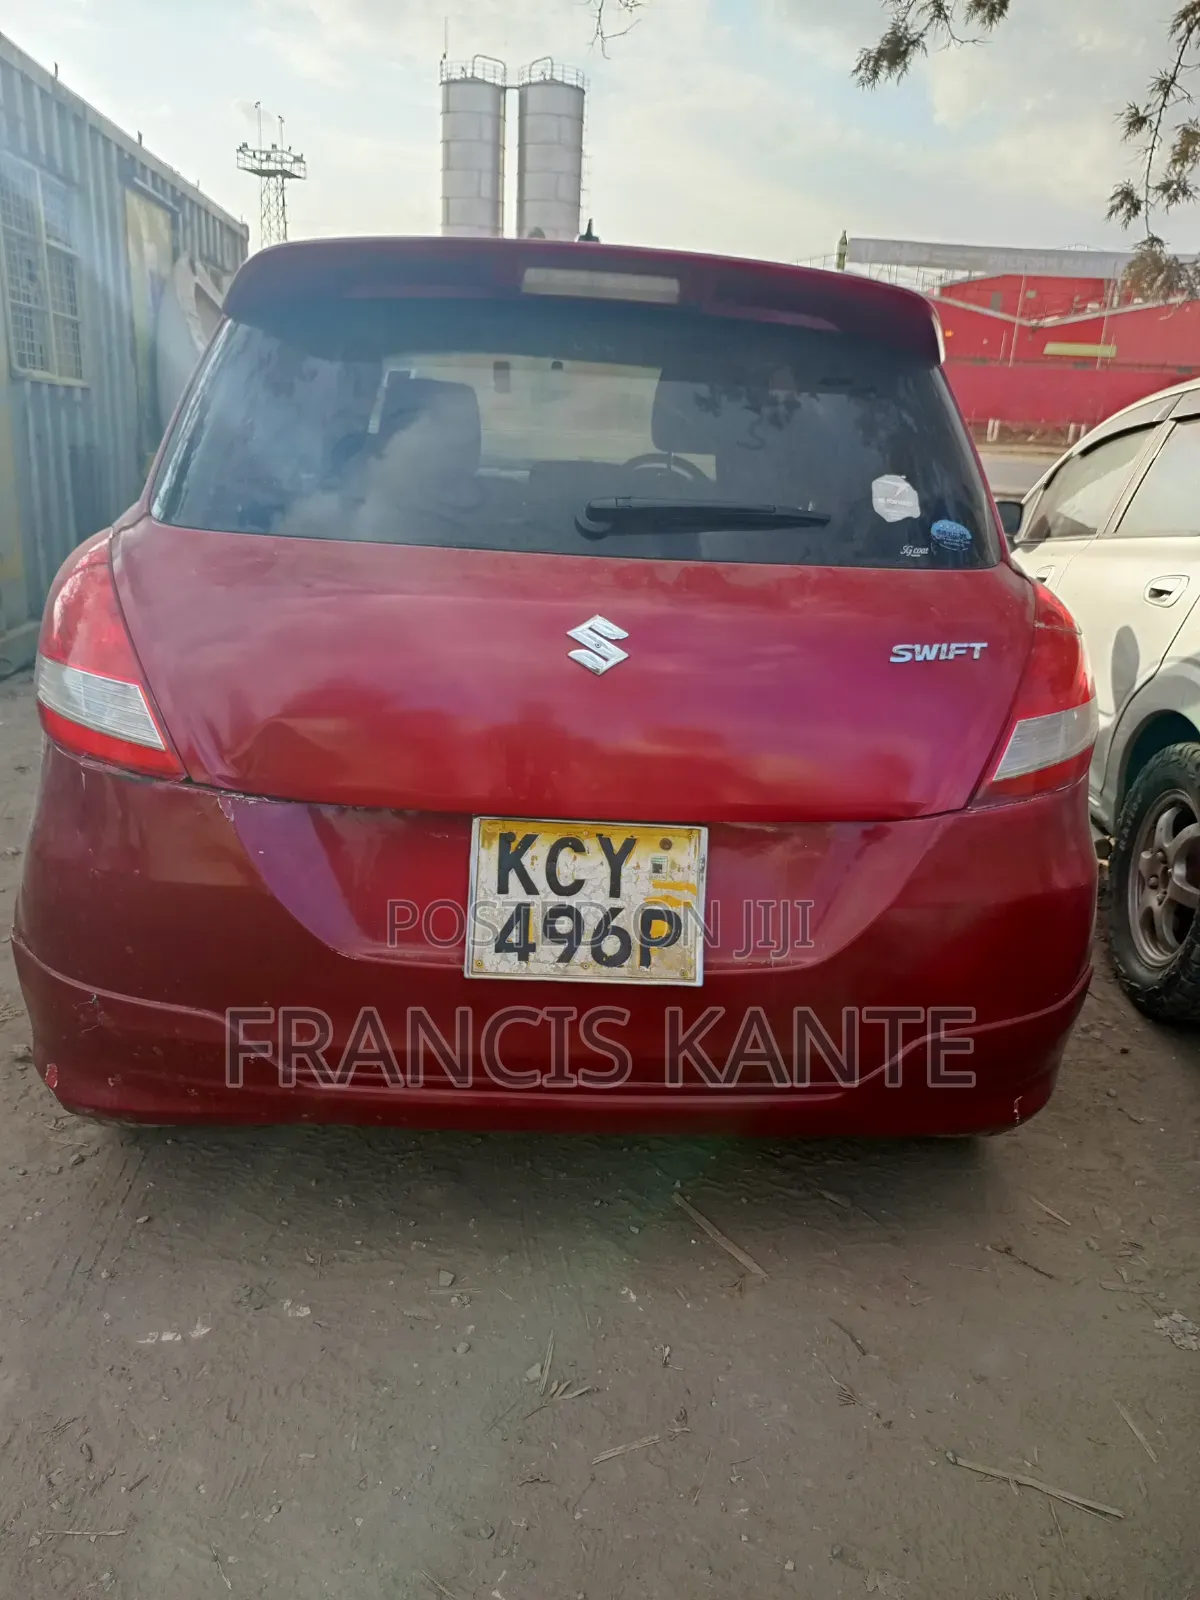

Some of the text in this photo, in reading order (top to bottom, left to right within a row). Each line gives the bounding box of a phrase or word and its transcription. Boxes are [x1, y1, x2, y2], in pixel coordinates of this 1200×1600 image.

[889, 642, 988, 663] SWIFT
[497, 832, 637, 898] KCY
[494, 902, 682, 968] 496P
